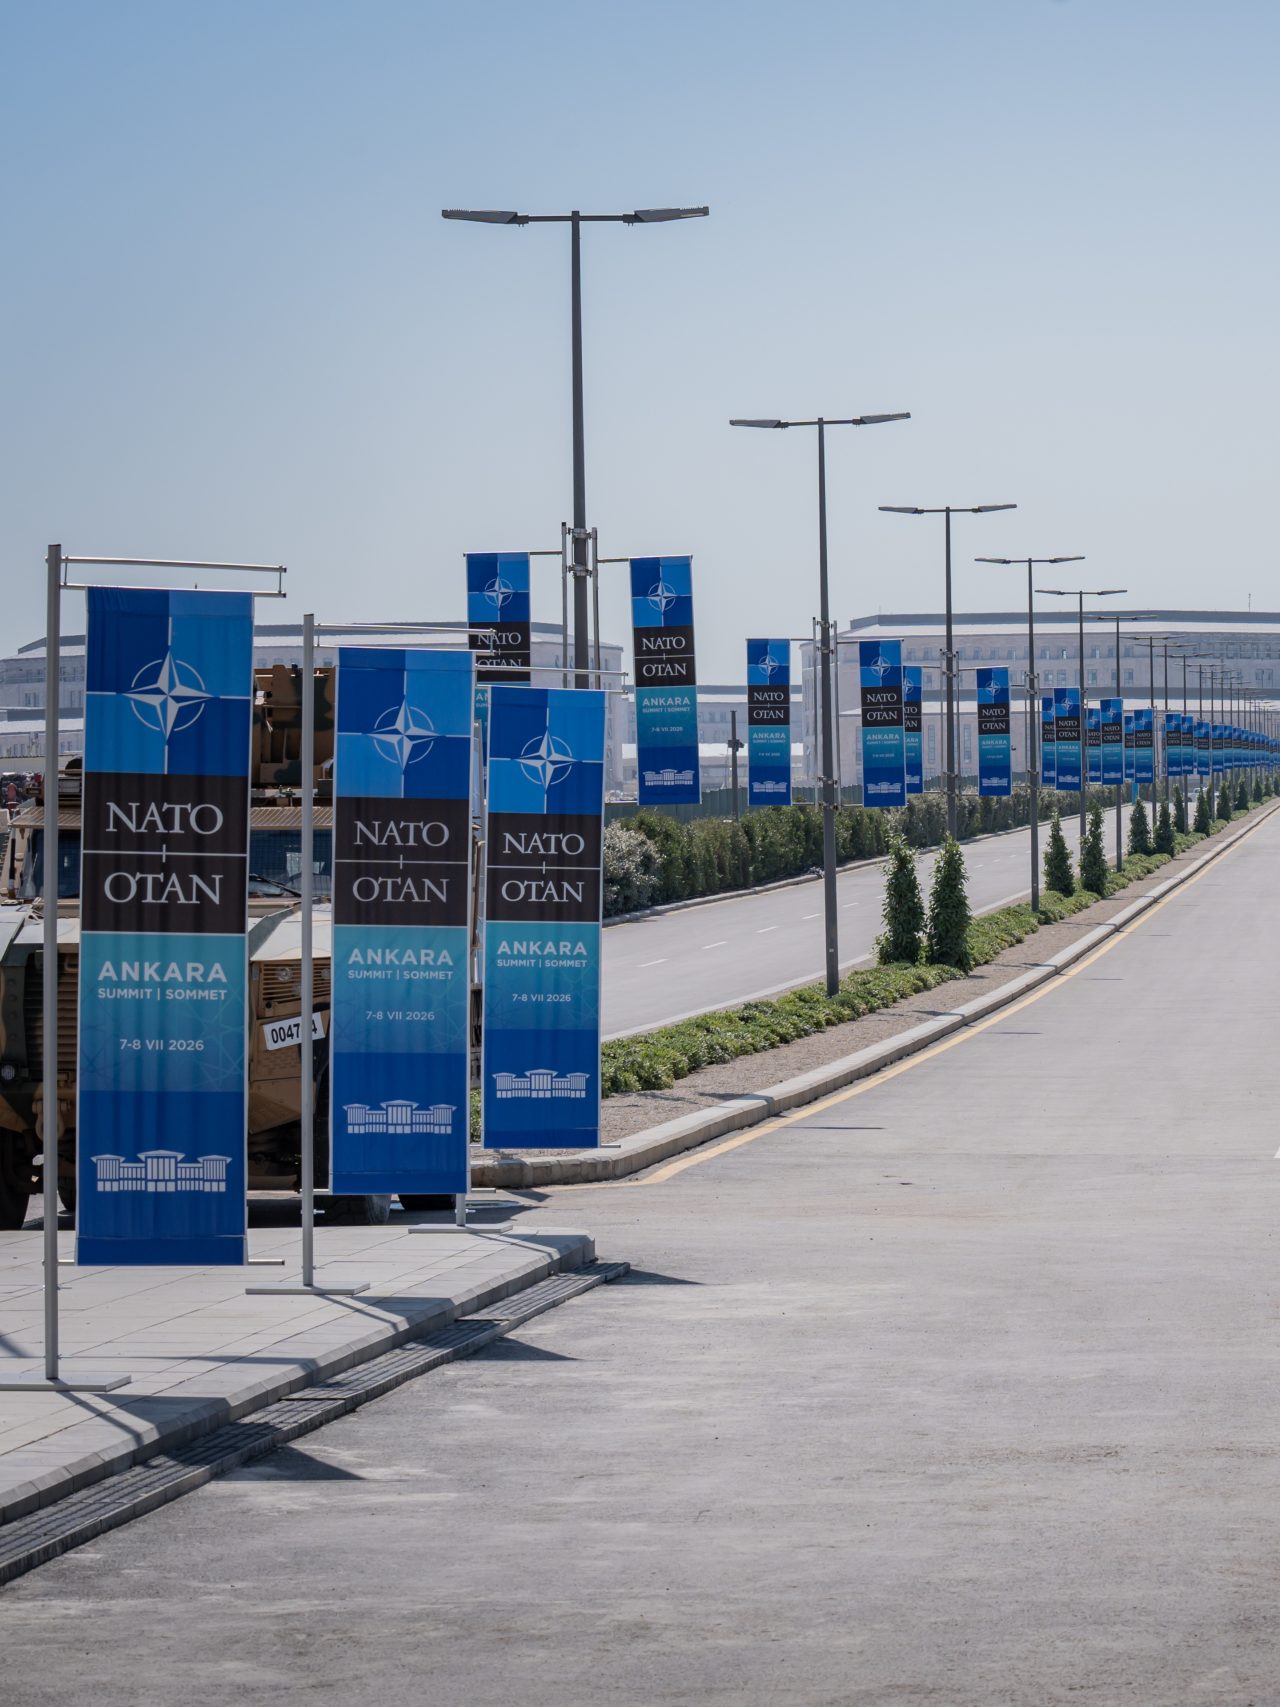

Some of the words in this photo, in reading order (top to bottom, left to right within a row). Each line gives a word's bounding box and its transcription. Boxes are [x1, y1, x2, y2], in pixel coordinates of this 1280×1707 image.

[477, 632, 522, 645] NATO
[642, 636, 686, 650] NATO
[642, 663, 687, 677] OTAN
[642, 696, 691, 706] ANKARA
[753, 692, 784, 701] NATO
[866, 693, 897, 703] NATO
[753, 710, 784, 719] OTAN
[866, 711, 898, 720] OTAN
[982, 708, 1006, 717] NATO
[982, 722, 1006, 730] OTAN
[106, 802, 223, 834] NATO
[355, 821, 449, 846] NATO
[503, 833, 584, 855] NATO
[104, 872, 223, 904] OTAN
[353, 877, 448, 902] OTAN
[502, 880, 584, 902] OTAN
[498, 941, 587, 955] ANKARA
[349, 948, 452, 965] ANKARA
[497, 958, 536, 967] SUMMIT
[545, 959, 588, 968] SOMMET
[98, 961, 227, 982] ANKARA
[348, 969, 392, 979] SUMMIT
[404, 970, 453, 980] SOMMET
[98, 987, 153, 1000] SUMMIT
[166, 988, 227, 1001] SOMMET
[512, 993, 529, 1002] 7-8
[531, 993, 544, 1002] VII
[547, 993, 572, 1003] 2026
[366, 1010, 384, 1021] 7-8
[388, 1011, 403, 1021] VII
[407, 1011, 435, 1021] 2026
[271, 1018, 318, 1044] 00474
[120, 1038, 142, 1050] 7-8
[146, 1039, 164, 1051] VII
[169, 1039, 205, 1051] 2026
